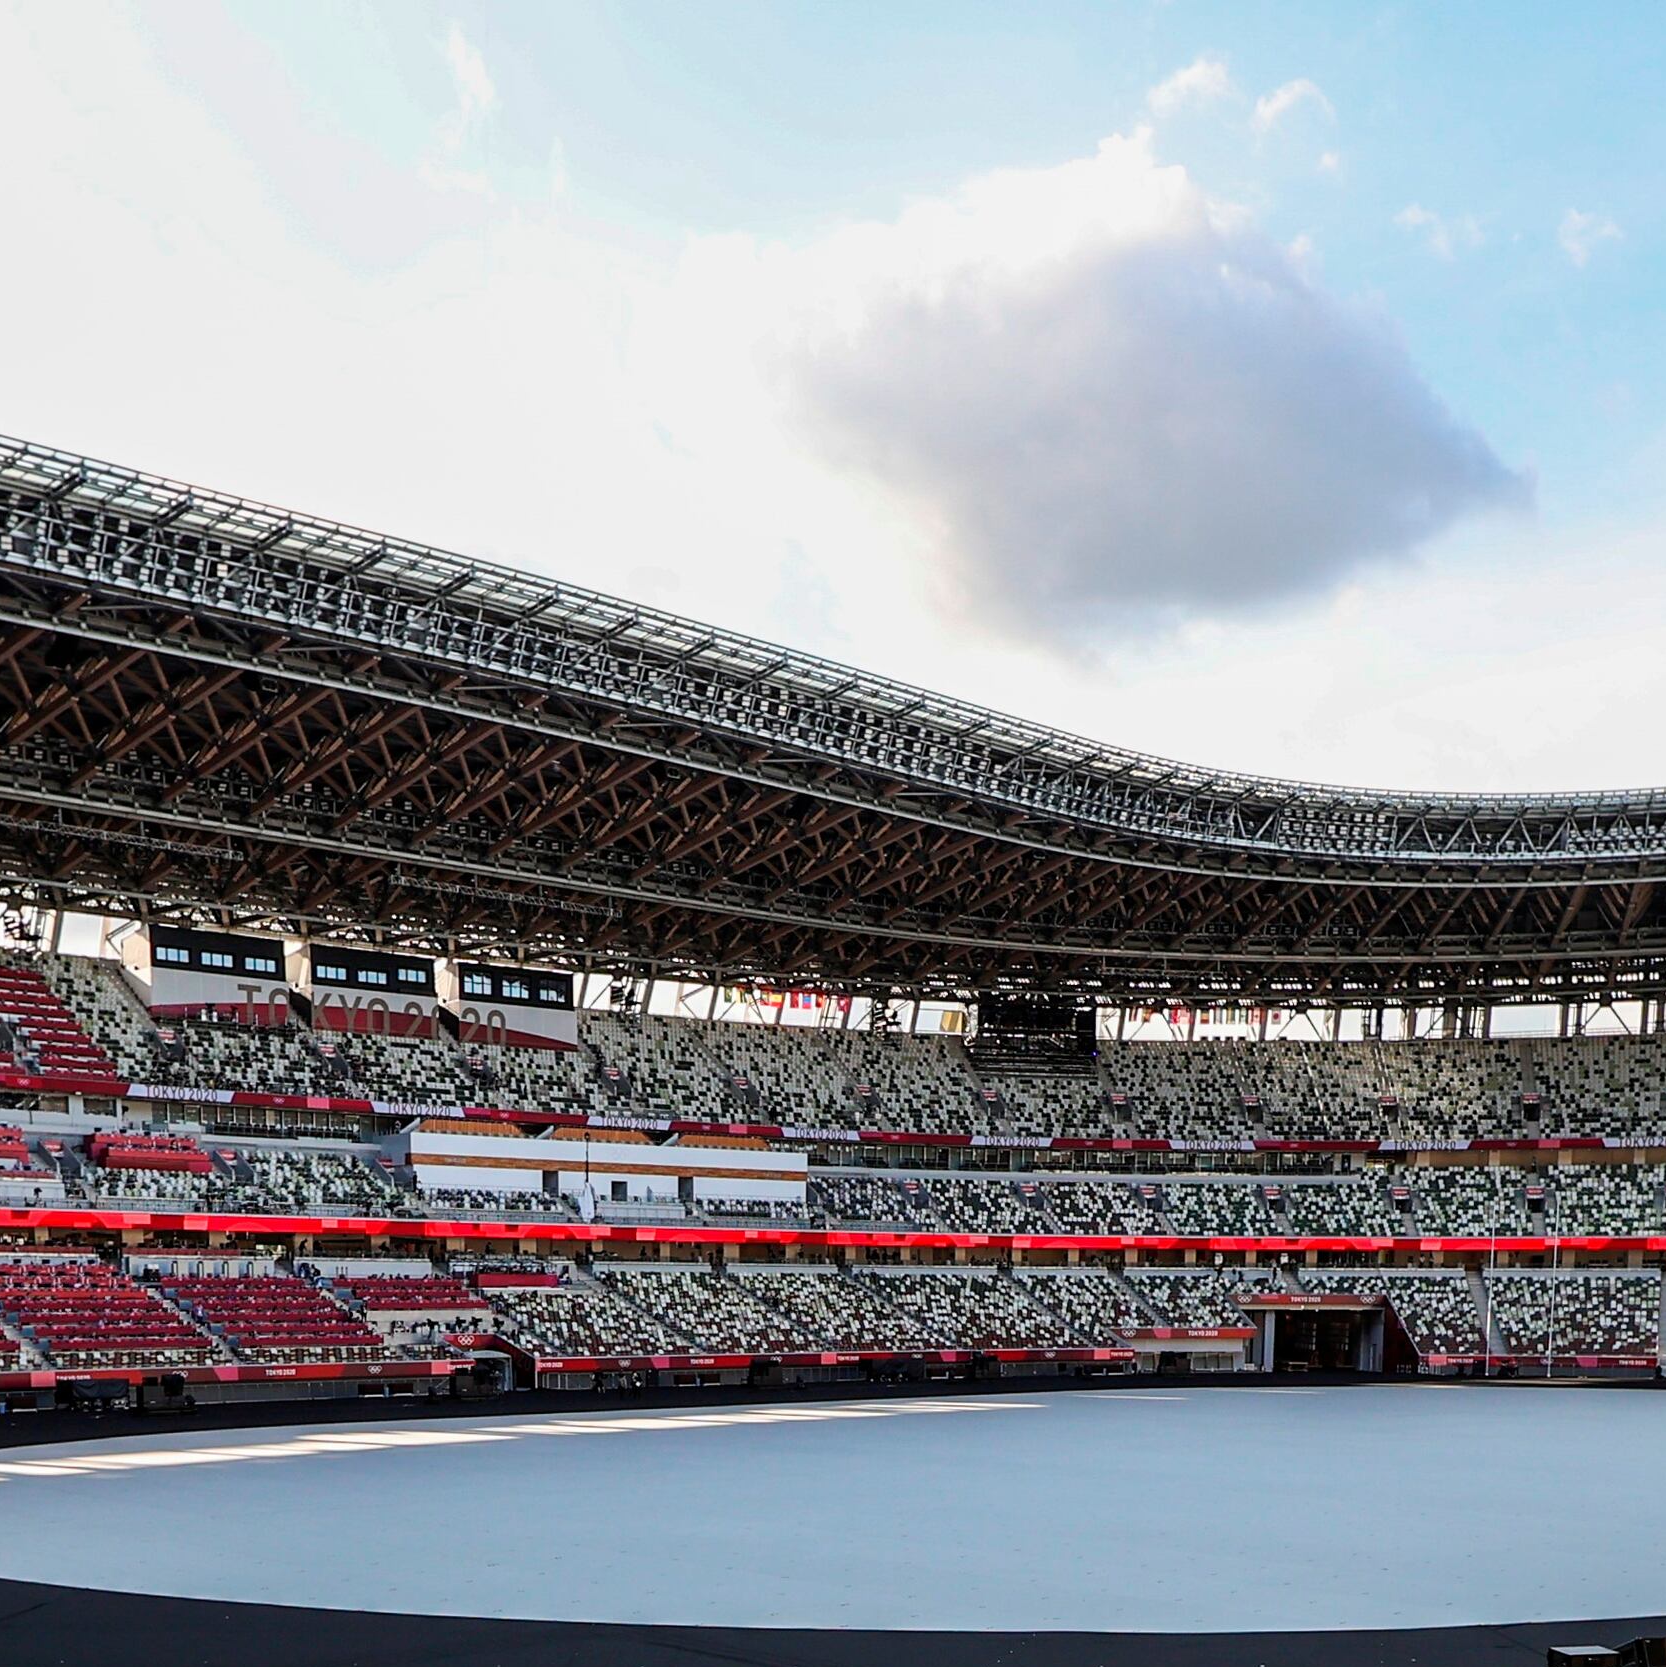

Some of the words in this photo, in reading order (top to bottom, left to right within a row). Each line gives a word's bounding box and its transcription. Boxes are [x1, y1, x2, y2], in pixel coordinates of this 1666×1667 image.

[146, 1084, 185, 1099] TOKYO
[189, 1087, 218, 1102] 2020
[387, 1103, 419, 1114] TOKYO
[423, 1104, 450, 1116] 2020
[601, 1117, 630, 1128] TOKYO
[633, 1118, 658, 1130] 2020
[794, 1127, 822, 1138] TOKYO
[824, 1129, 847, 1141] 2020
[984, 1136, 1014, 1147] TOKYO
[1017, 1137, 1040, 1148] 2020
[1184, 1140, 1215, 1150] TOKYO
[1219, 1141, 1242, 1151] 2020
[1394, 1141, 1427, 1151] TOKYO
[1431, 1141, 1456, 1151] 2020
[1619, 1136, 1654, 1147] TOKYO
